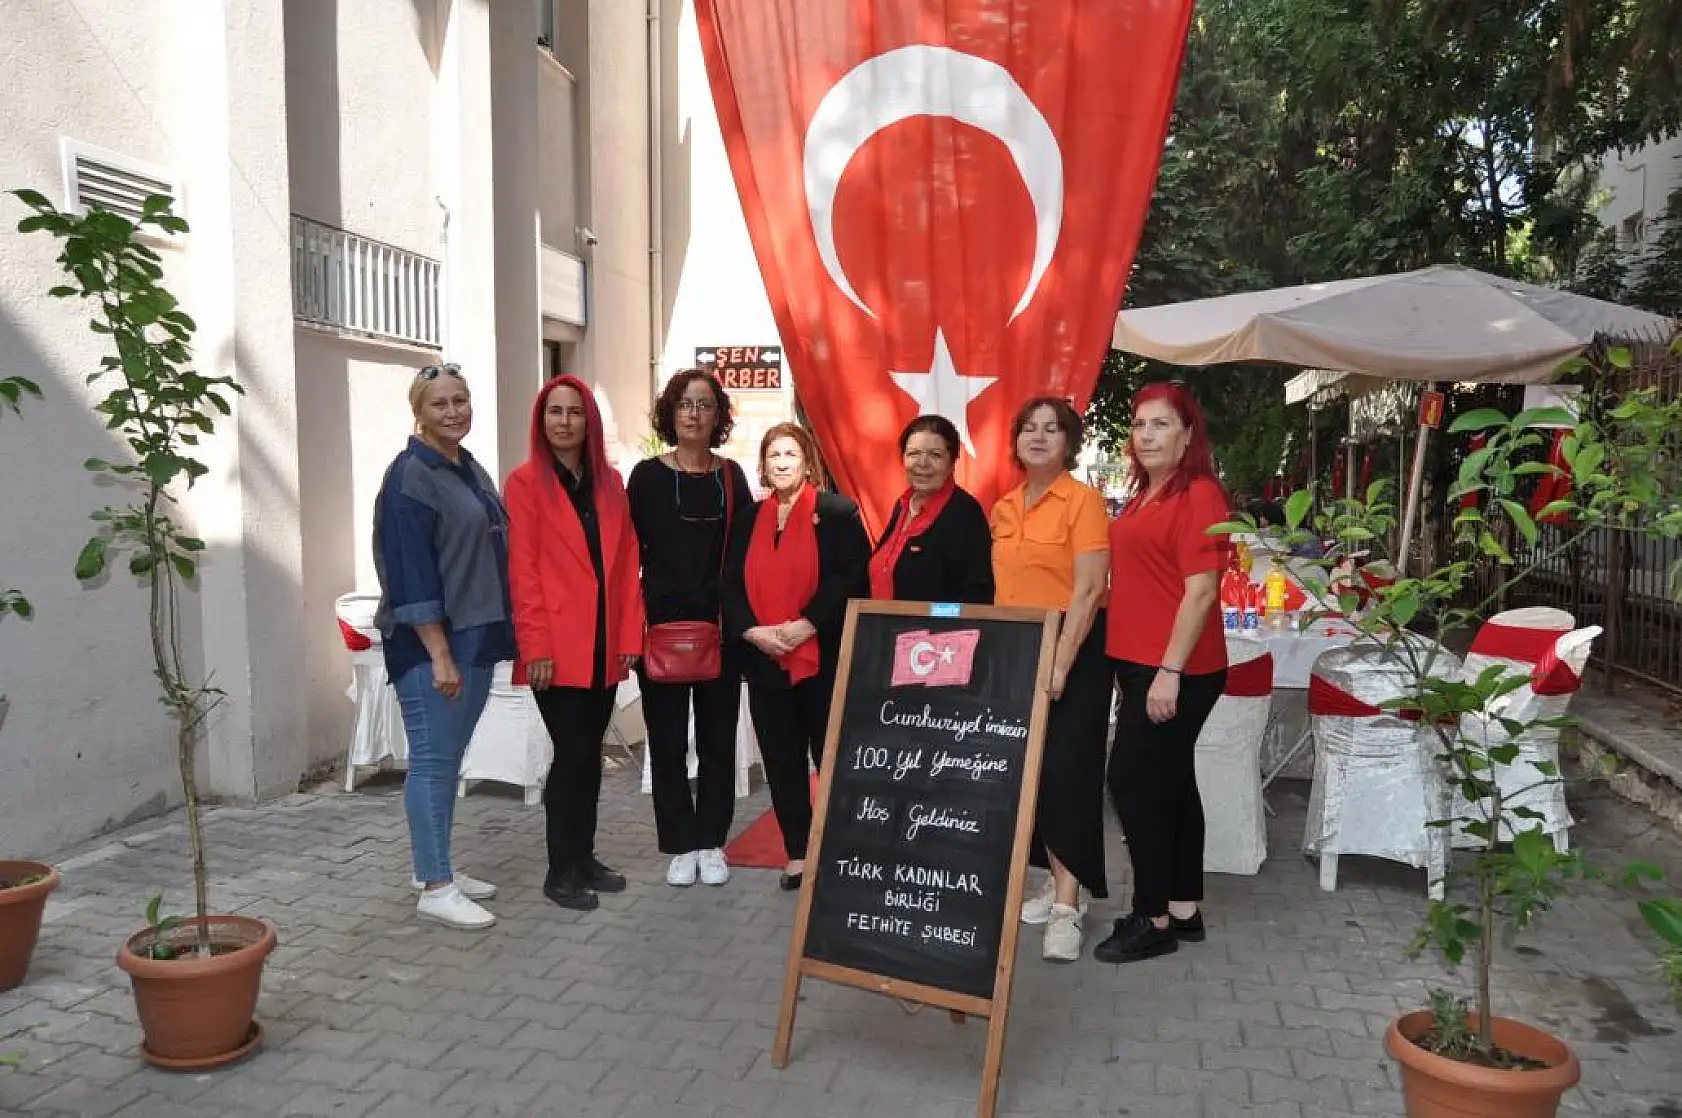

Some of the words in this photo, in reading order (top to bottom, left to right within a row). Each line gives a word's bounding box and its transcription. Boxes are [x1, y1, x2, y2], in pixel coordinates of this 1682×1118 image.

[716, 347, 759, 368] ŞEN
[713, 367, 780, 388] ARBER
[853, 746, 892, 770] 100.
[906, 804, 981, 841] Geldiniz
[836, 856, 883, 881] TÜRK
[894, 863, 984, 896] KADINLAR
